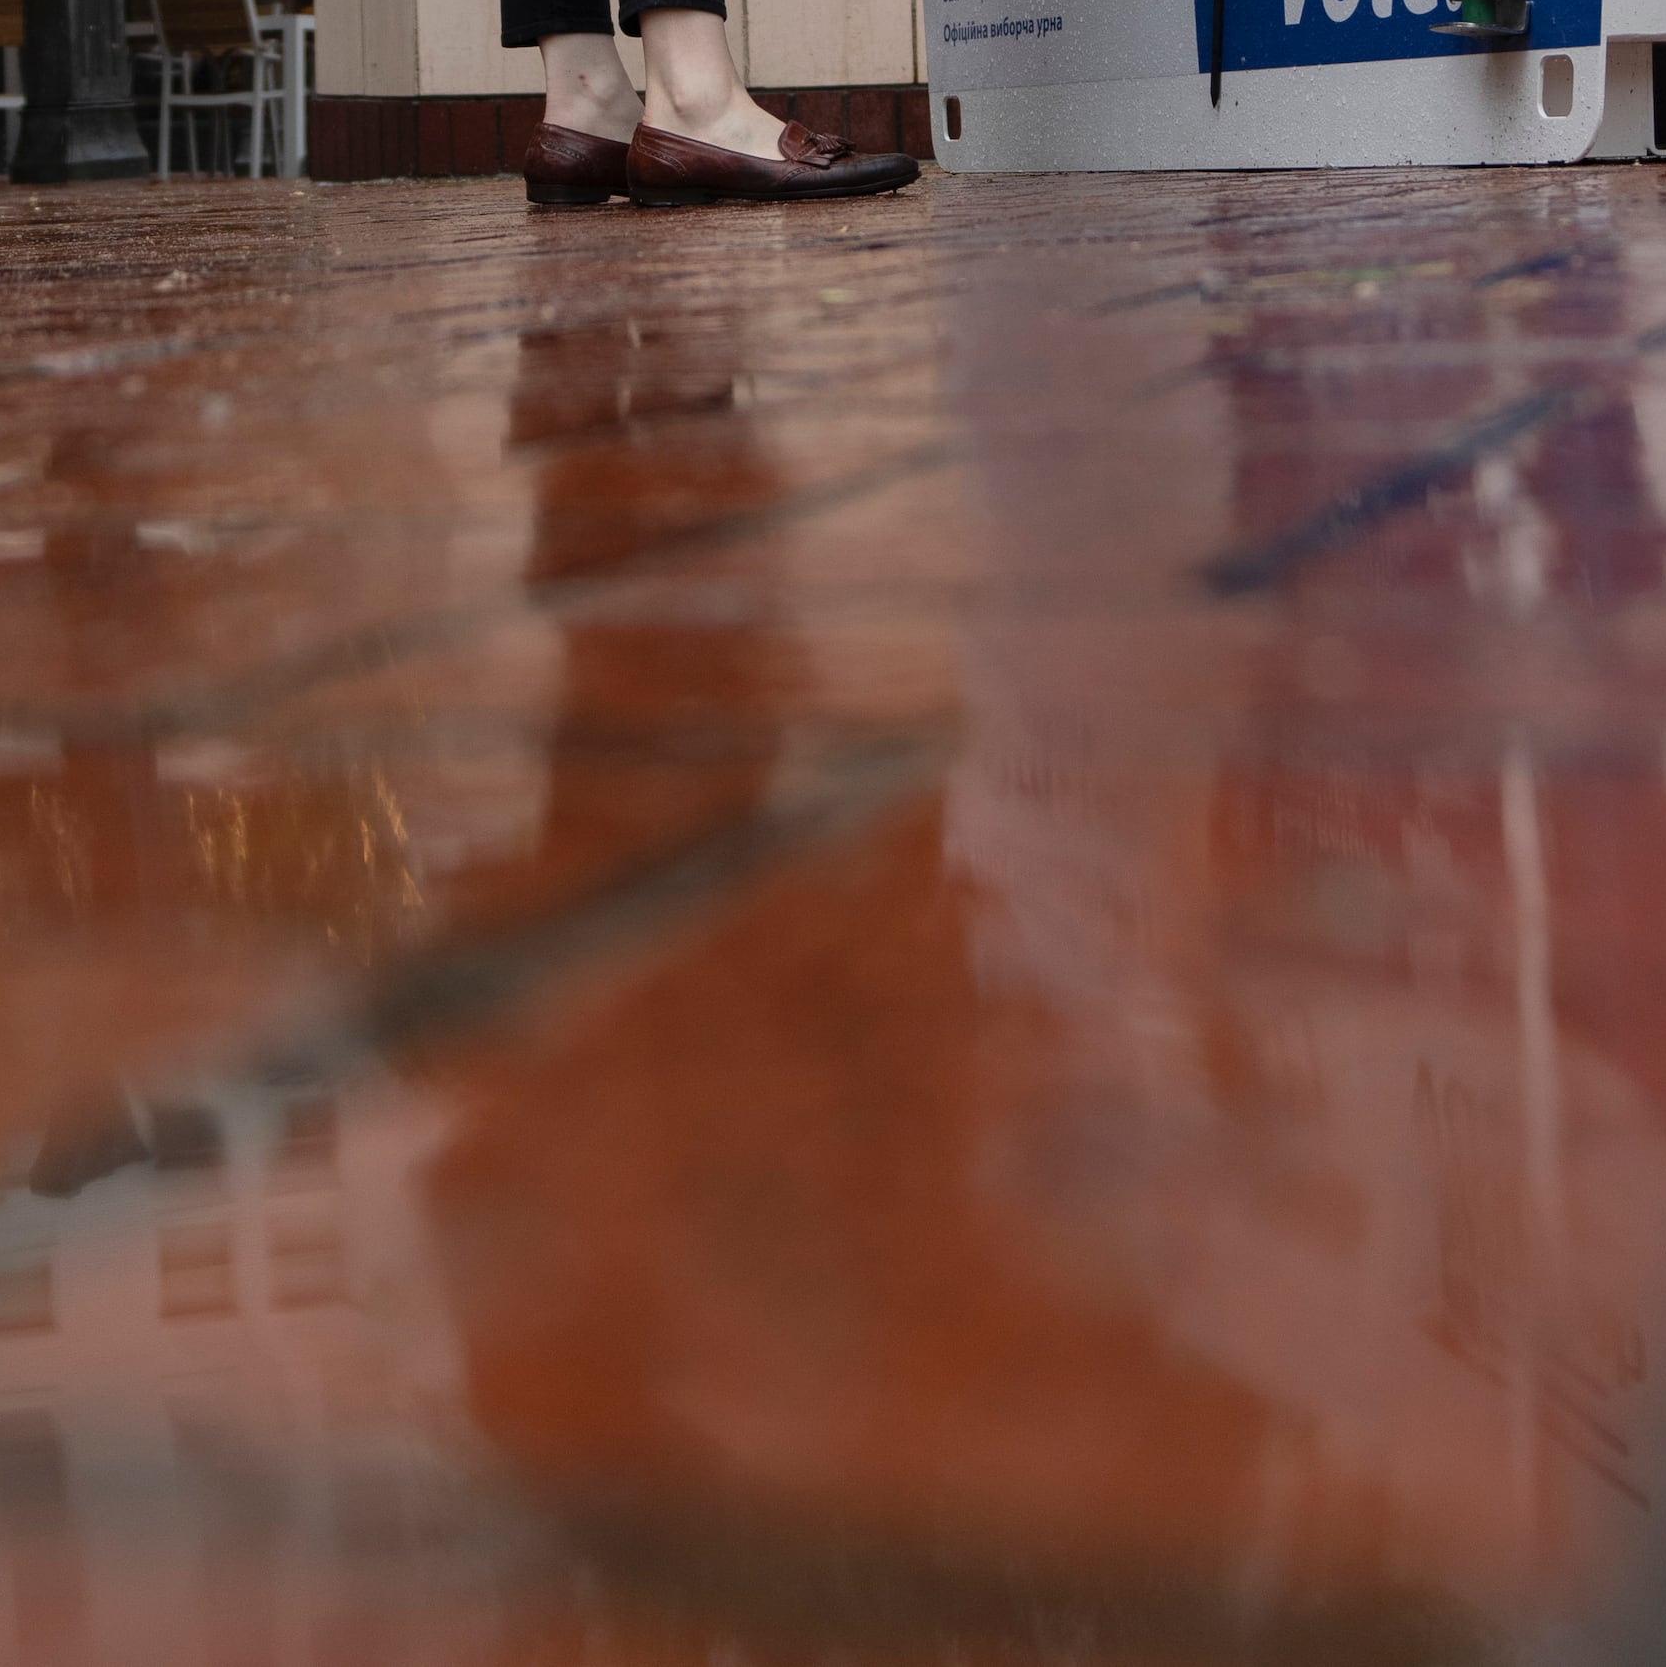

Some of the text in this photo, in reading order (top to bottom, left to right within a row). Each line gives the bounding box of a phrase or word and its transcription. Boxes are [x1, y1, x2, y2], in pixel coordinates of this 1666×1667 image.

[943, 15, 1062, 46] Офіційна виборча урна
